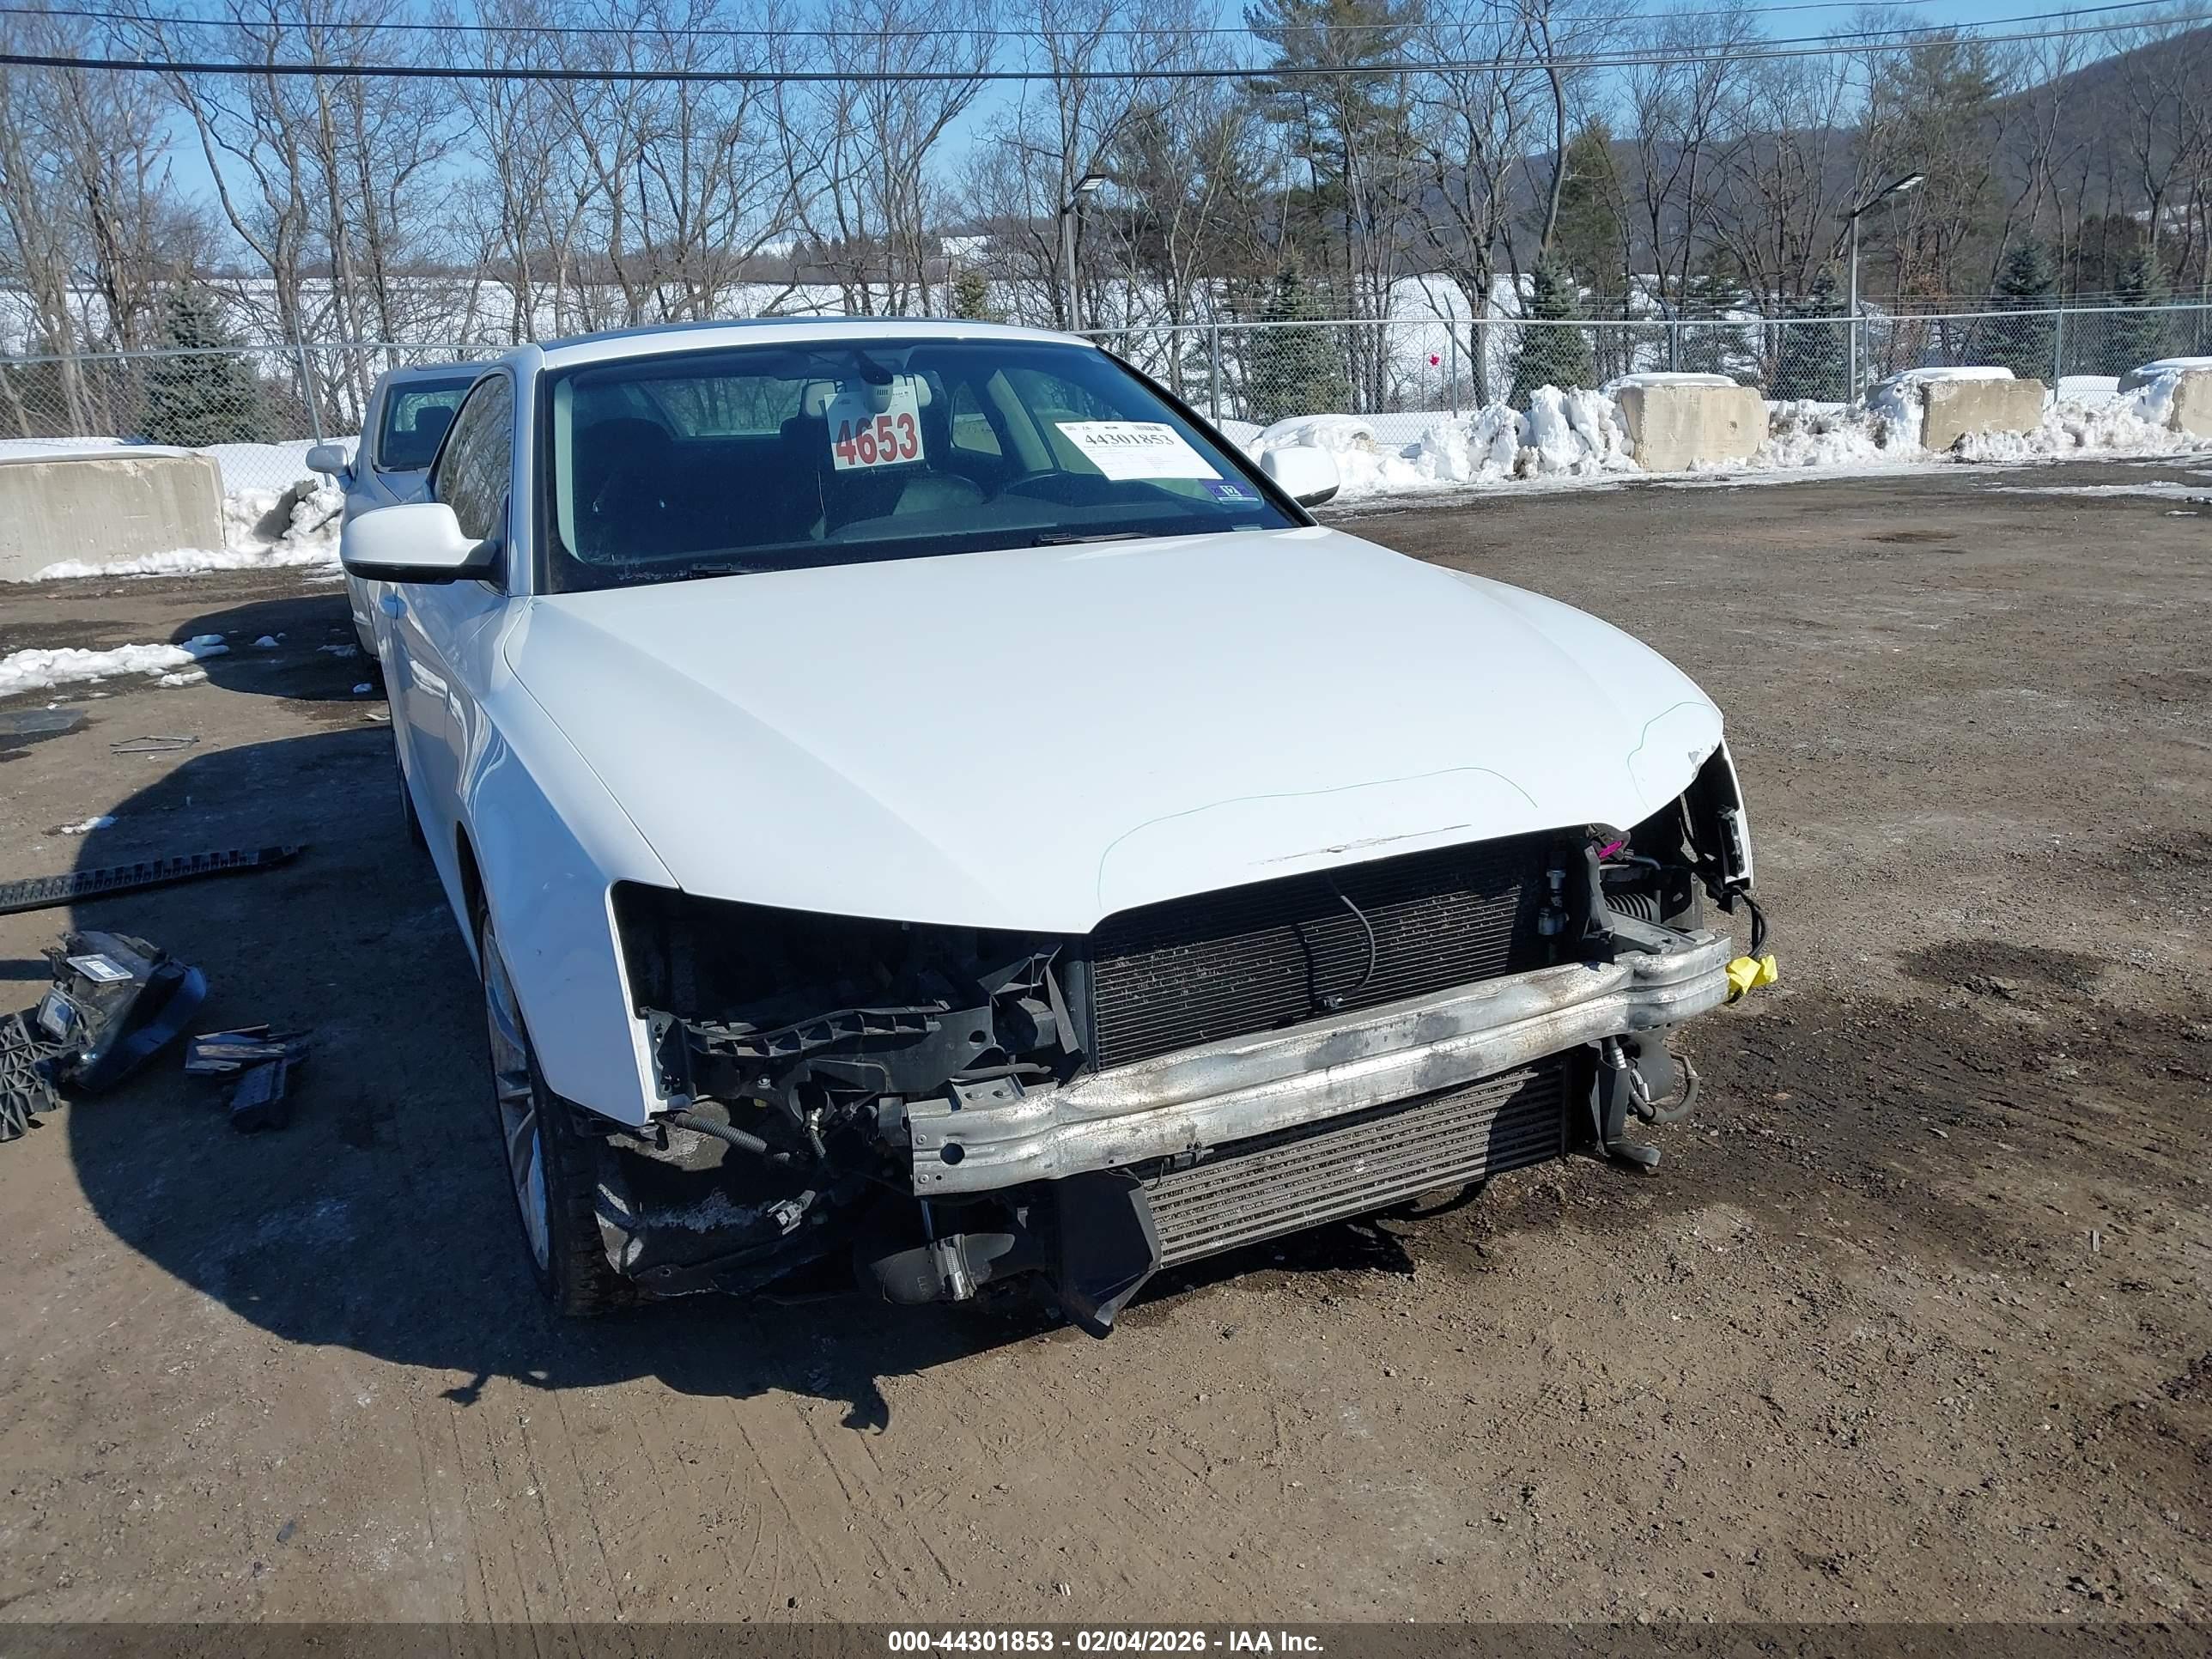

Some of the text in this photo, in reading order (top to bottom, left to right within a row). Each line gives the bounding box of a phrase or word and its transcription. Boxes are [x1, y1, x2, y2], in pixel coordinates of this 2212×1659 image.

[836, 412, 918, 465] 4653
[1085, 433, 1175, 446] 44301853
[1222, 486, 1239, 495] 12
